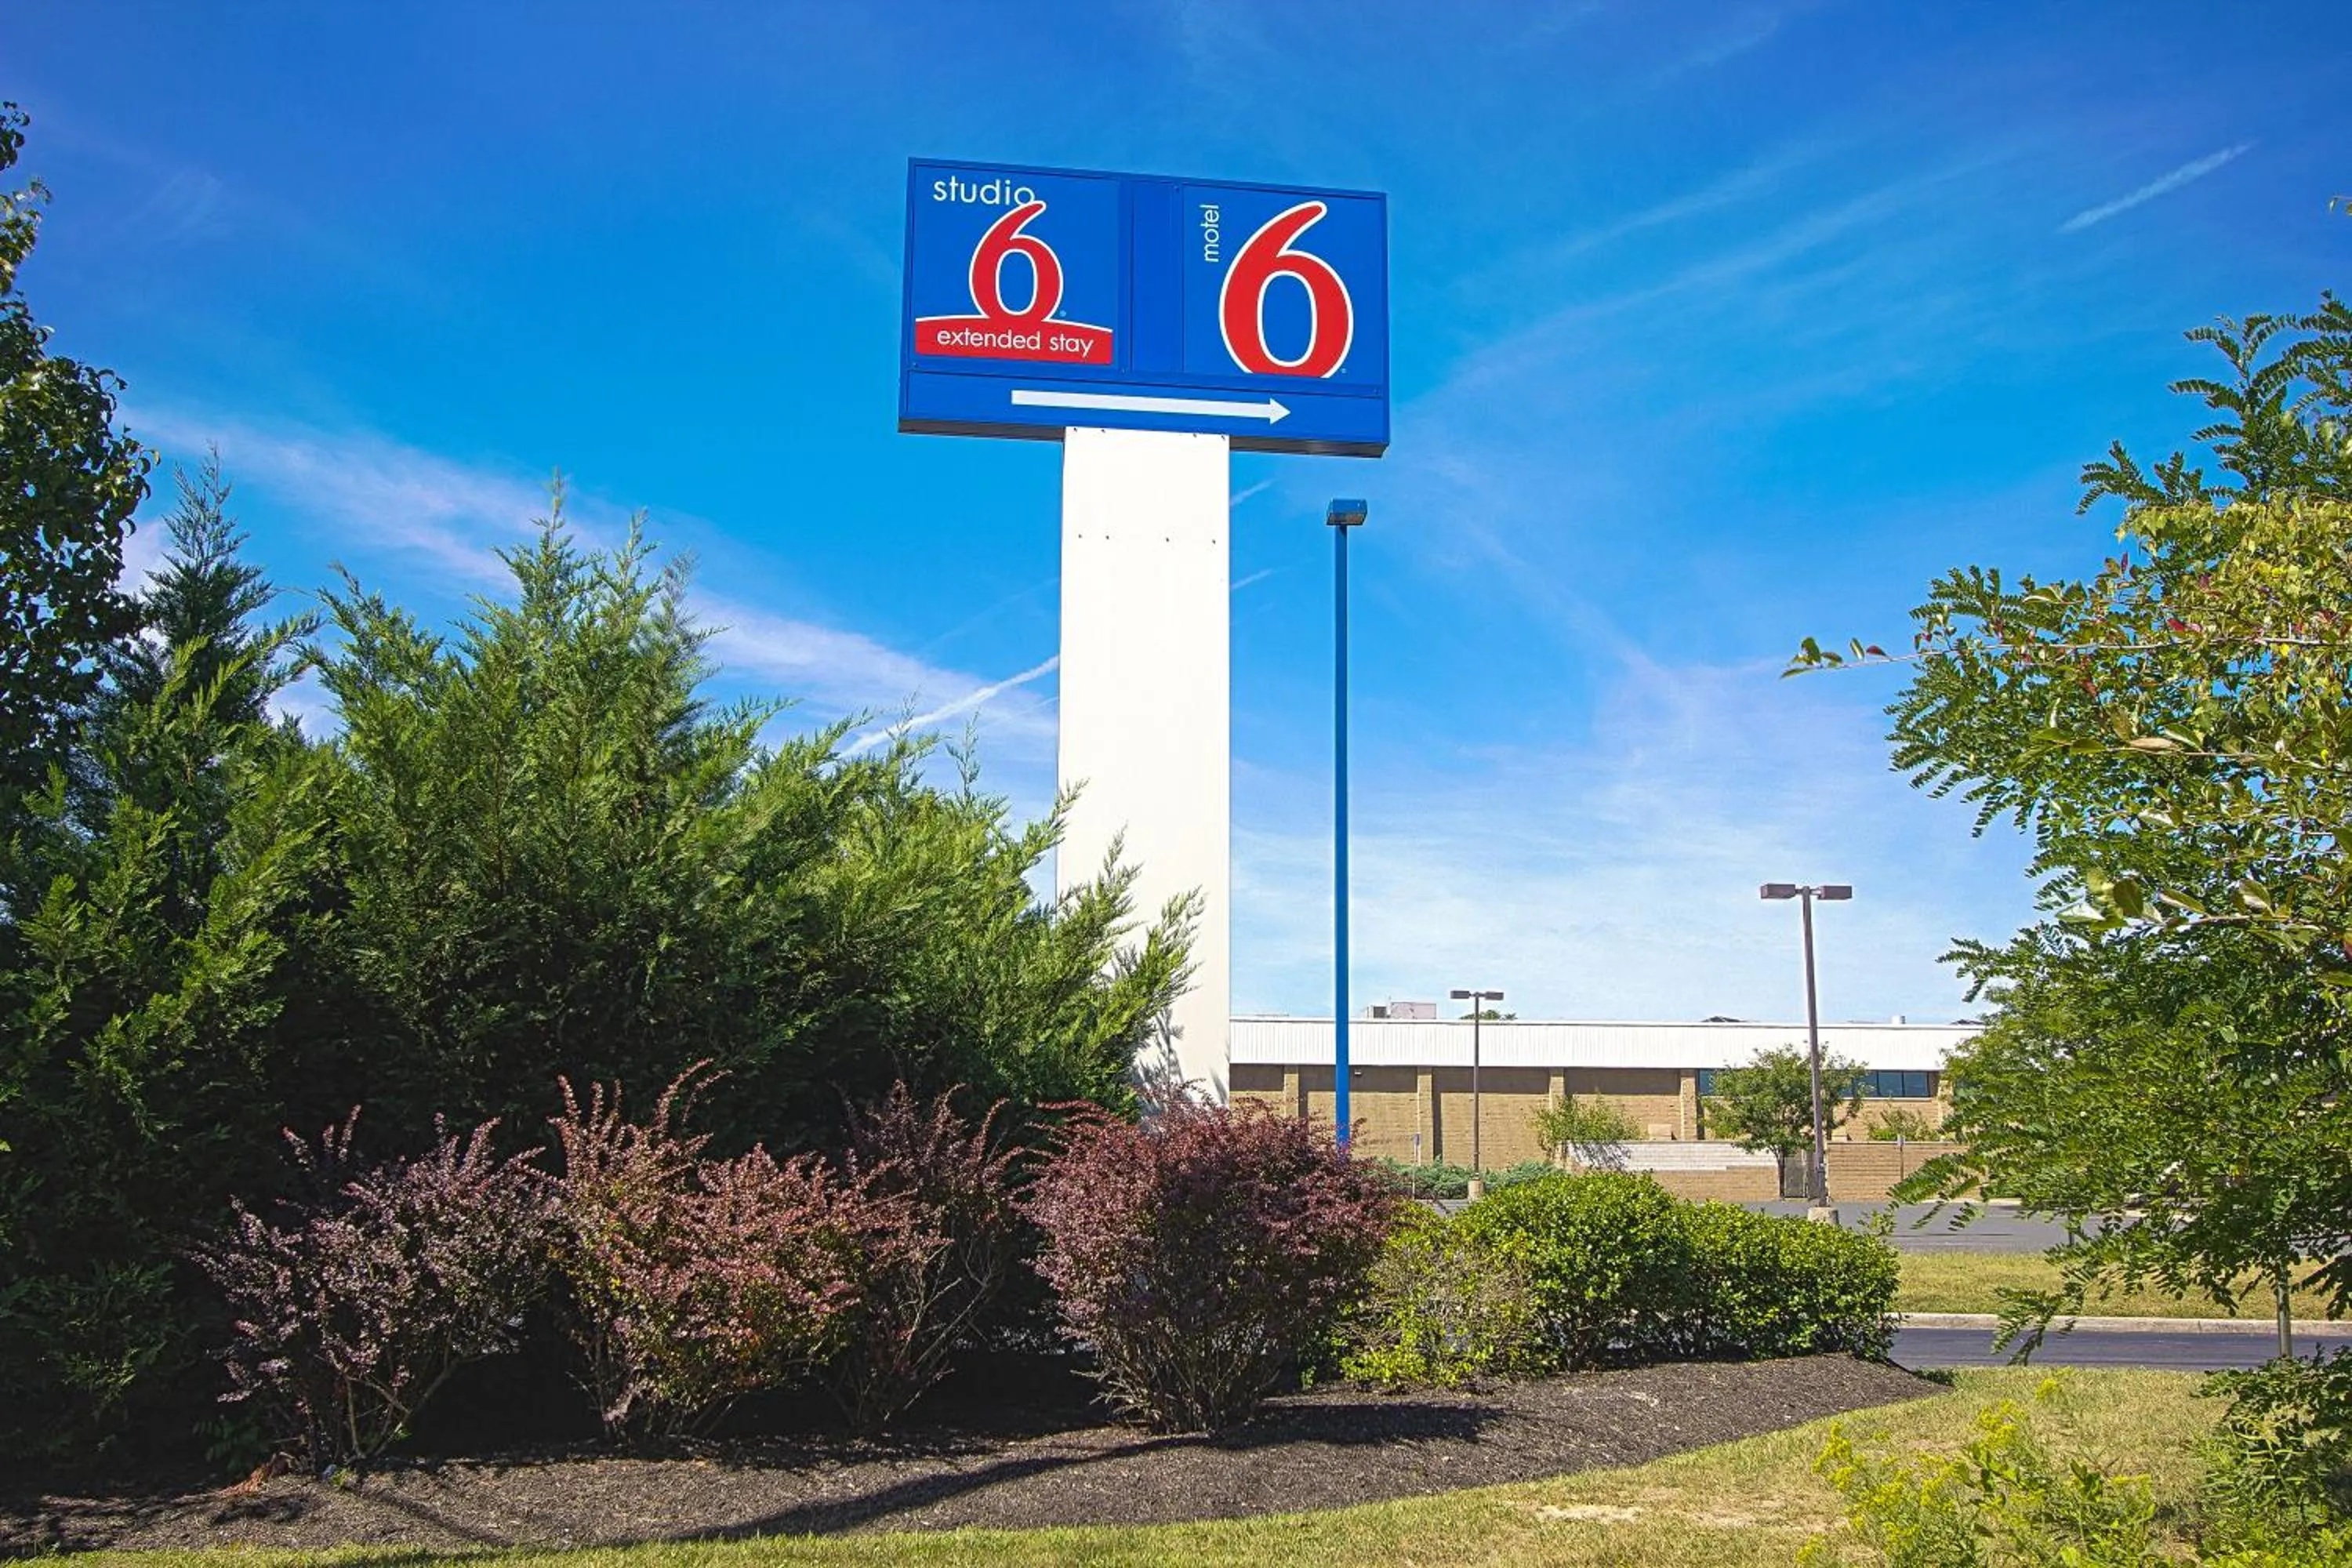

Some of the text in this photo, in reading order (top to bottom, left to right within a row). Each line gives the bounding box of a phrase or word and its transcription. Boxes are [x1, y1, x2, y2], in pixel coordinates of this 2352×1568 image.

[933, 176, 1036, 206] studio
[968, 200, 1064, 320] 6
[1200, 204, 1219, 263] motel
[1218, 200, 1354, 379] 6
[936, 327, 1094, 358] extended stay
